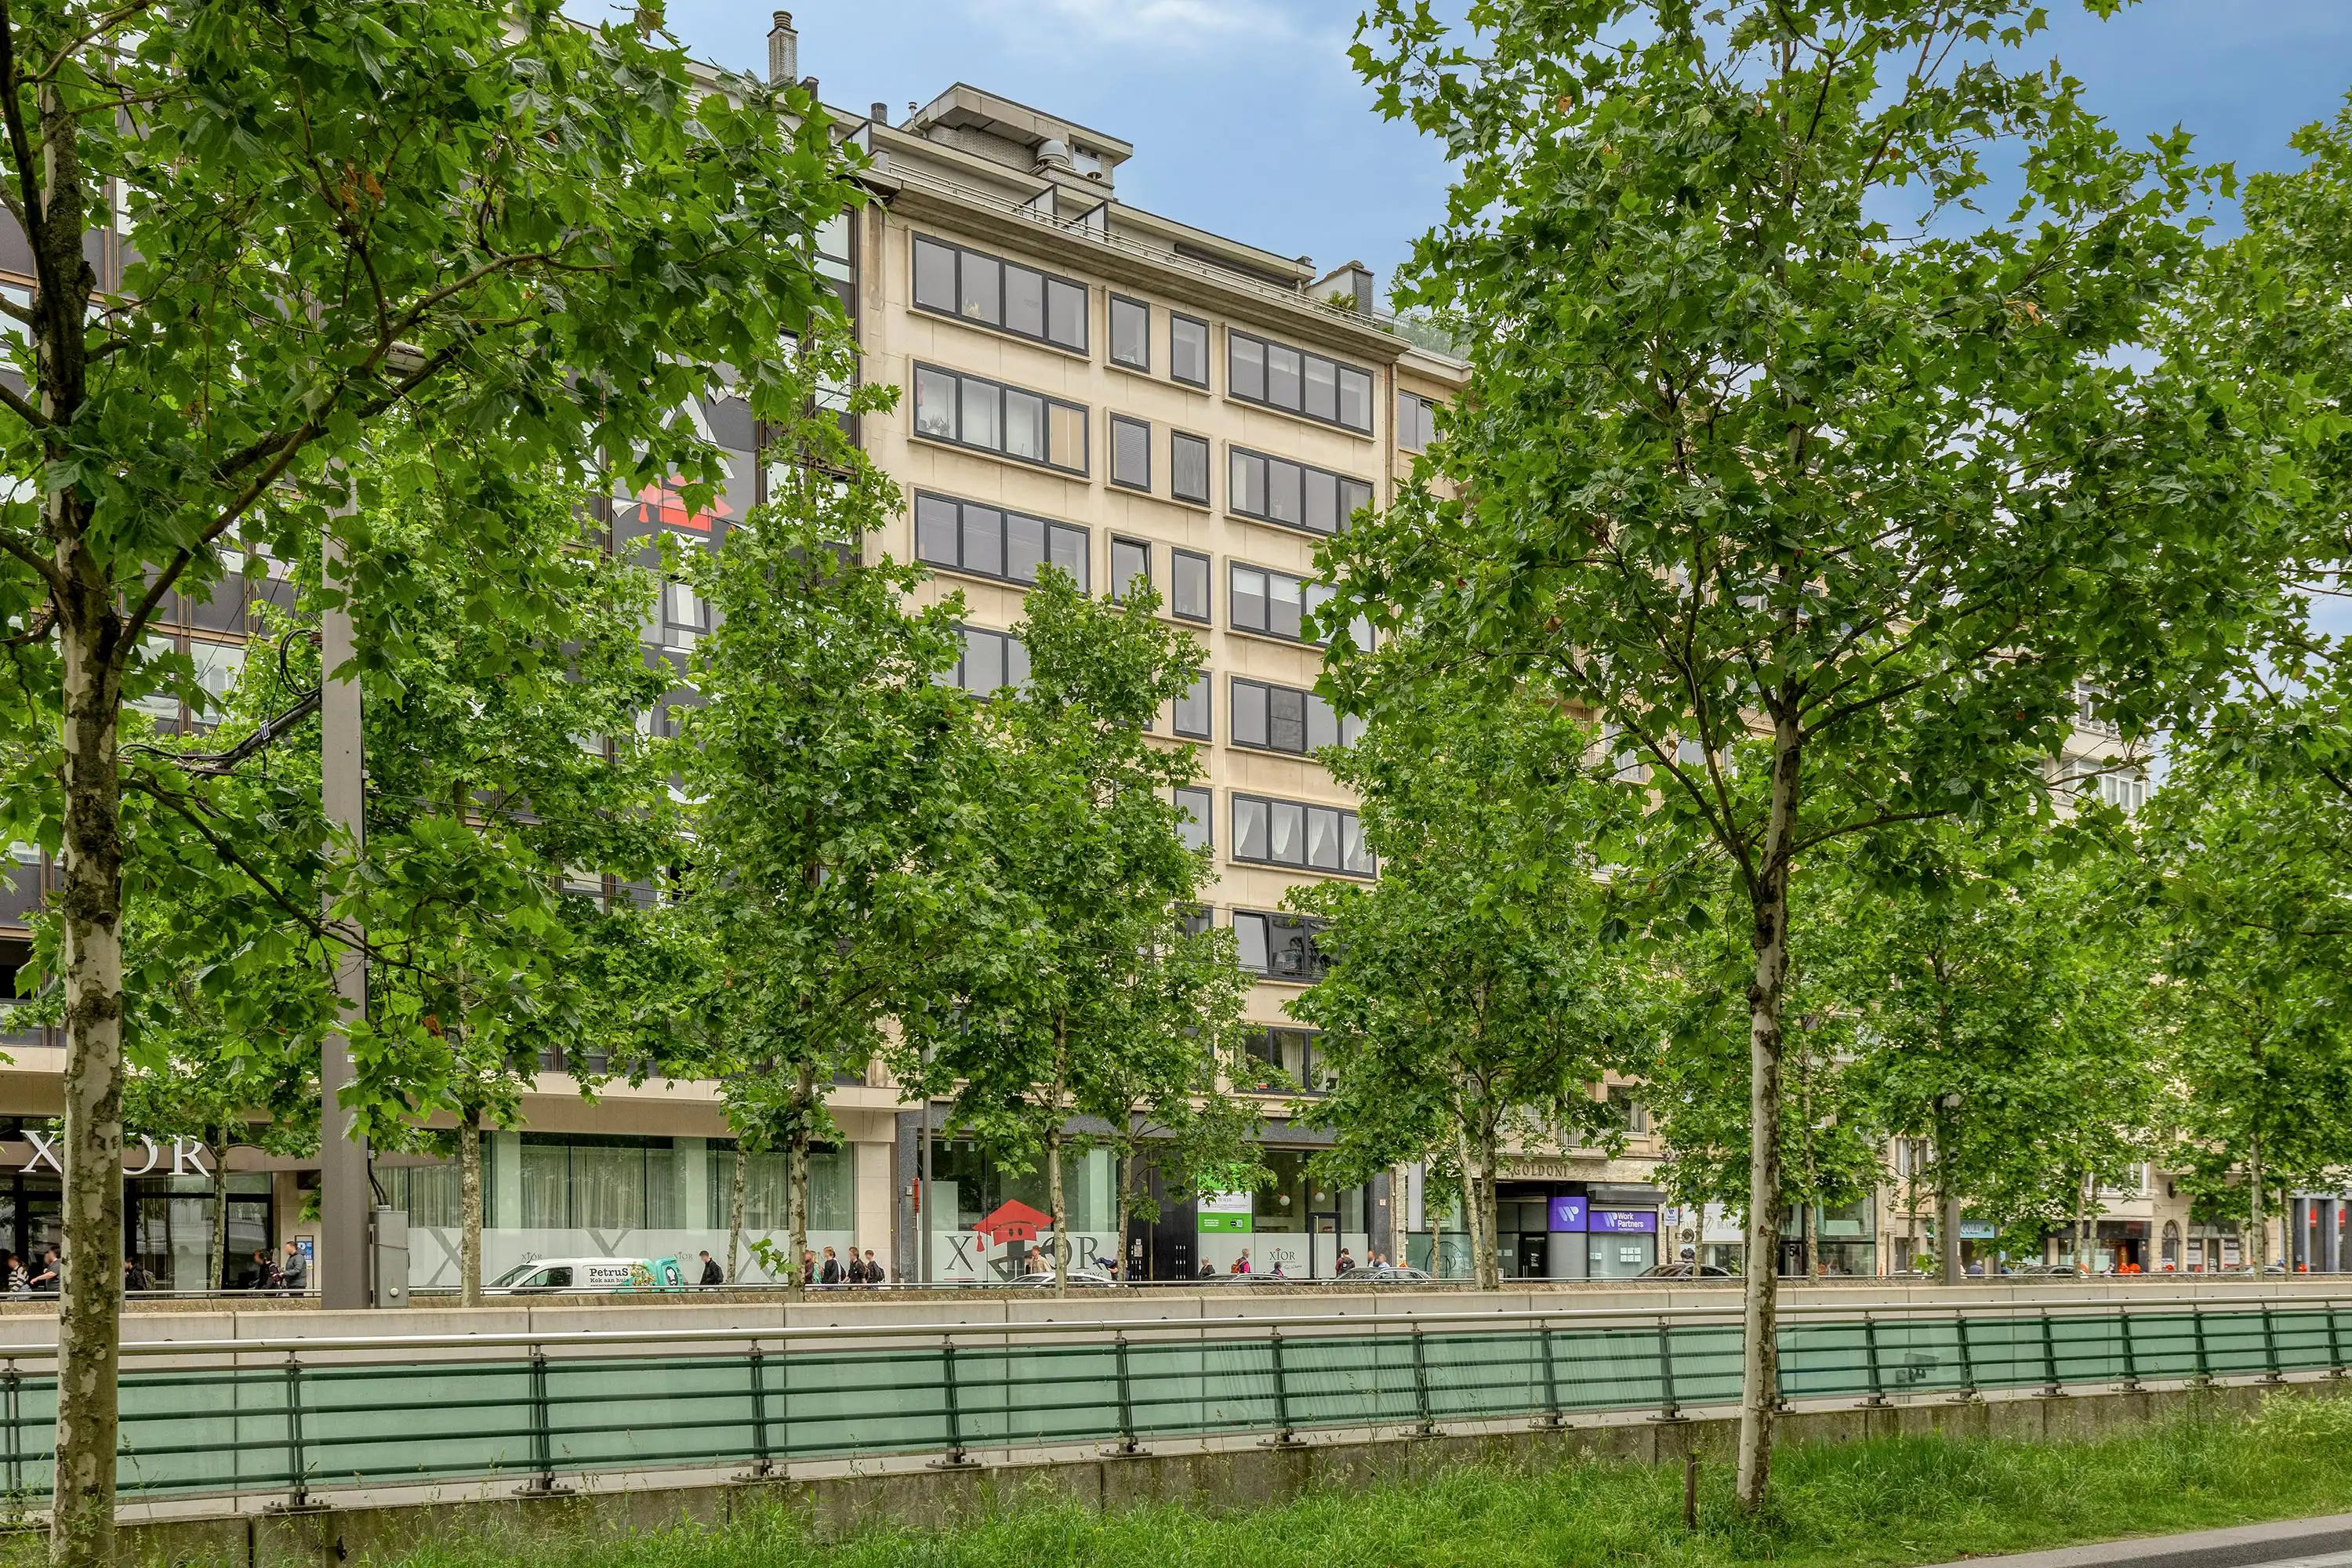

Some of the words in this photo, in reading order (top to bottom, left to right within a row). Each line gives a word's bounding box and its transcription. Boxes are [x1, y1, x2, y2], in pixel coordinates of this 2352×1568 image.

[1513, 1164, 1567, 1177] GOLDONI
[1270, 1251, 1295, 1260] XIOR
[1789, 1245, 1800, 1256] 54
[590, 1268, 628, 1276] PetruS
